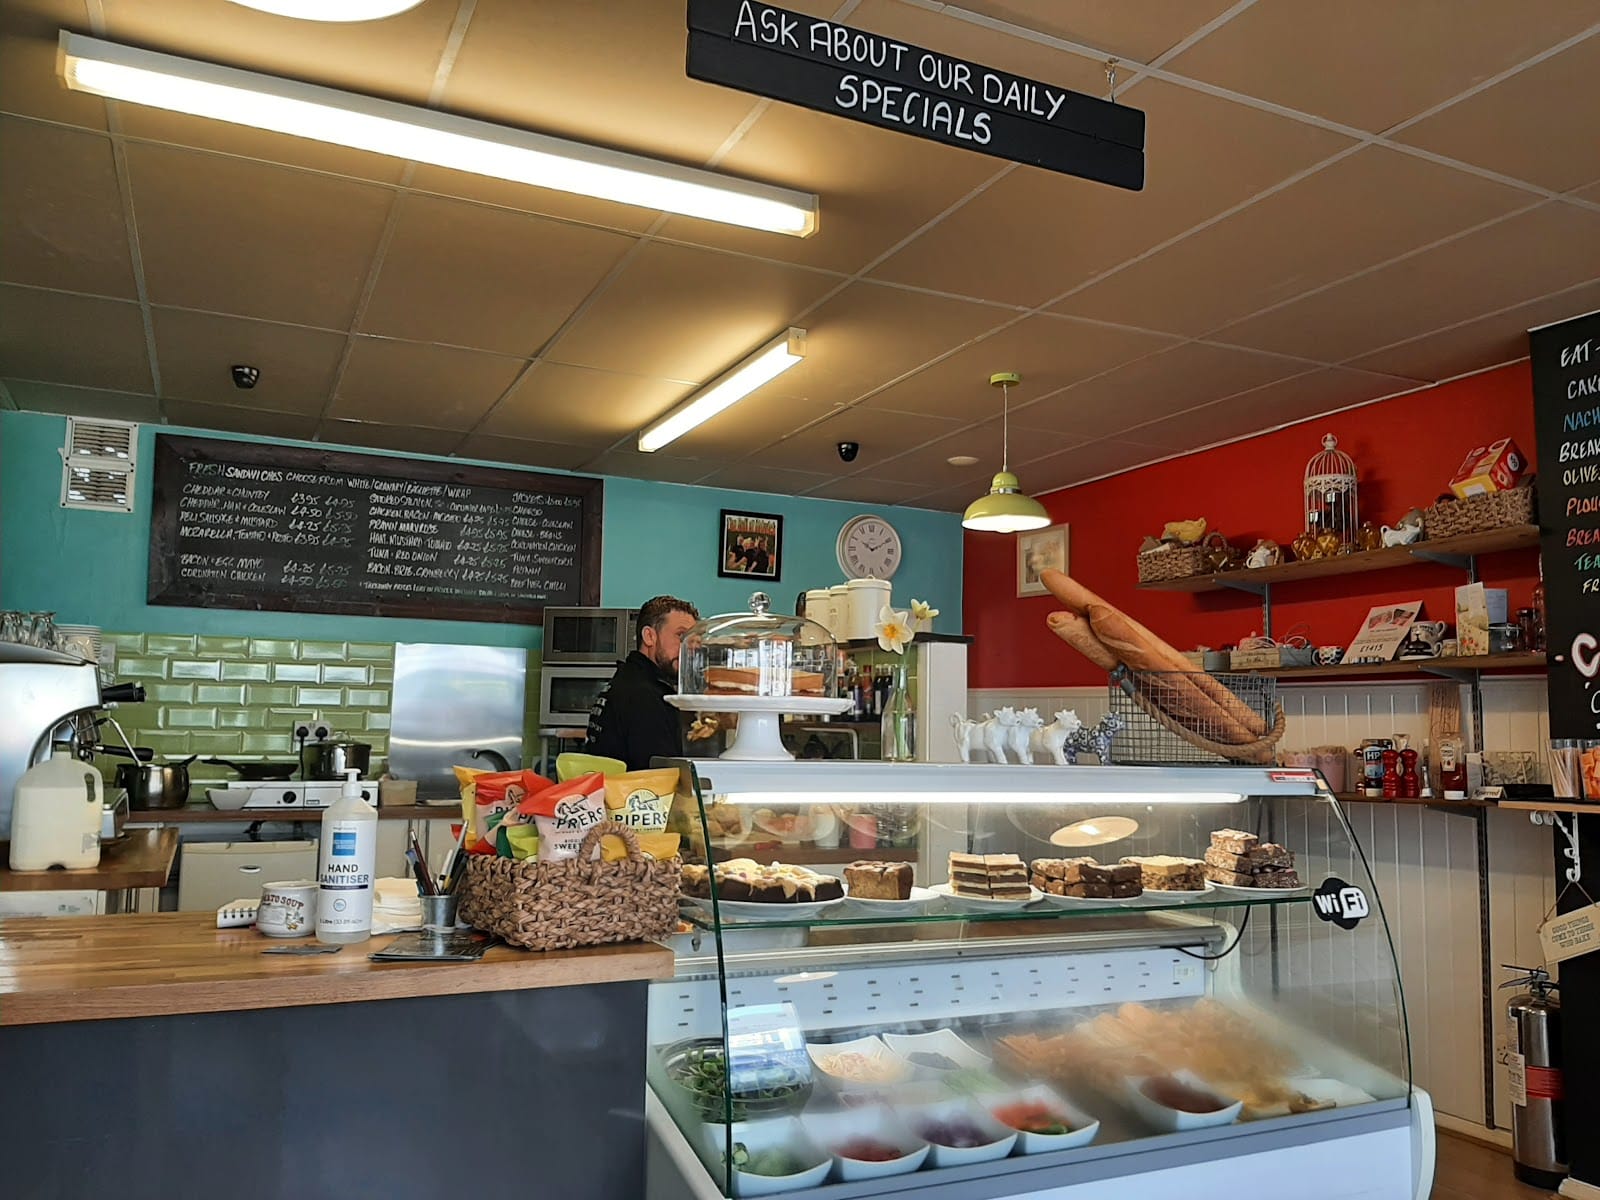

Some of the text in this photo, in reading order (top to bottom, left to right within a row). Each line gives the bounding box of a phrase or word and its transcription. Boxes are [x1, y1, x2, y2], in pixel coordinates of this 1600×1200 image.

[734, 0, 1066, 121] ASK ABOUT OUR DAILY
[834, 74, 993, 145] SPECIALS
[225, 466, 284, 482] SANDWICHES
[285, 471, 319, 485] CHOOSE
[318, 475, 344, 487] FROM
[1562, 464, 1600, 486] OLIVE
[231, 487, 270, 501] CHUTNEY
[247, 502, 288, 516] COLESLAW
[1566, 496, 1600, 517] PLOU
[179, 511, 199, 523] DELI
[368, 518, 399, 532] PRAWN
[367, 546, 390, 560] TUNA
[394, 550, 411, 562] RED
[410, 551, 439, 563] ONION
[180, 568, 228, 581] CORONATION
[1367, 751, 1381, 761] HP
[614, 811, 668, 827] PIPERS
[328, 863, 359, 873] HAND
[320, 873, 369, 885] SANITISER
[280, 896, 305, 911] SOUP
